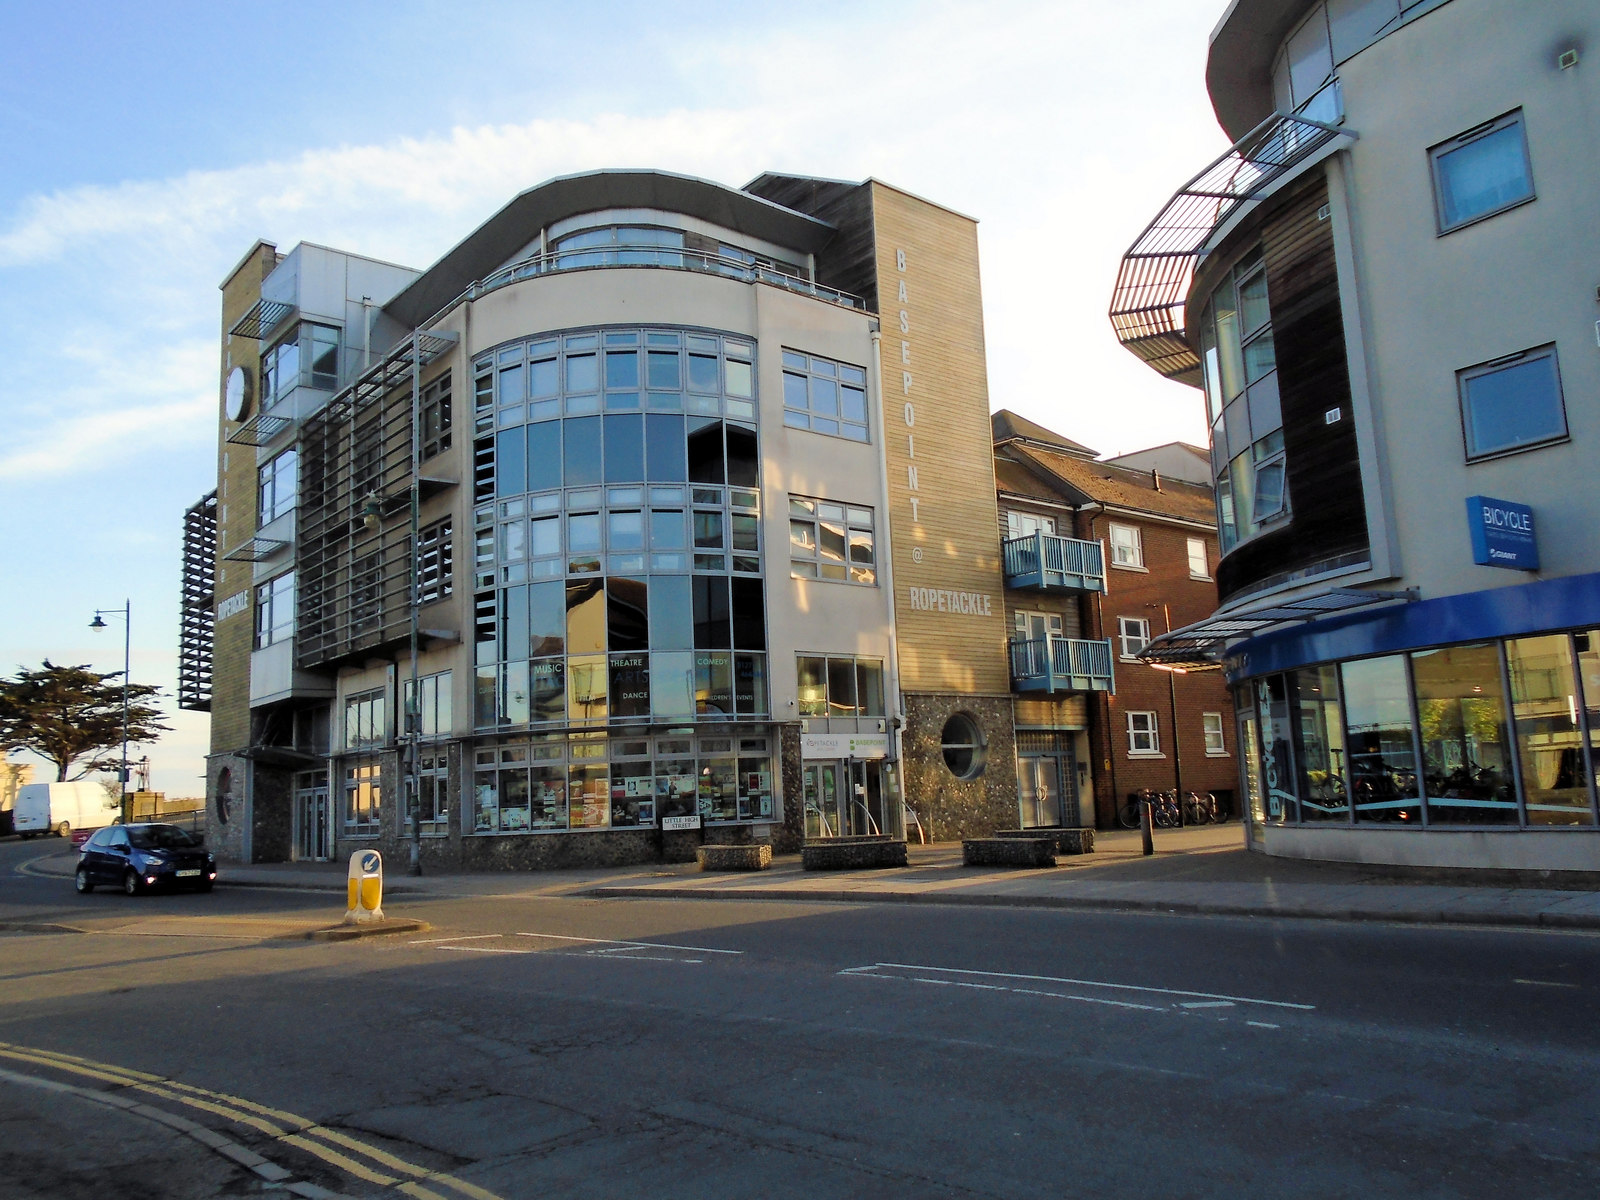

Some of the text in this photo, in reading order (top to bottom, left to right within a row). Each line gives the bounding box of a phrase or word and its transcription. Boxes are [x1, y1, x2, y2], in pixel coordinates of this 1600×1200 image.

[896, 248, 920, 523] BASEPOINT
[1483, 506, 1531, 531] BICYCLE
[912, 546, 924, 564] @
[910, 586, 993, 617] ROPETACKLE
[534, 663, 562, 674] MUSIC
[610, 658, 643, 667] THEATRE
[697, 658, 729, 666] COMEDY
[614, 669, 649, 684] ARTS
[622, 691, 648, 700] DANCE
